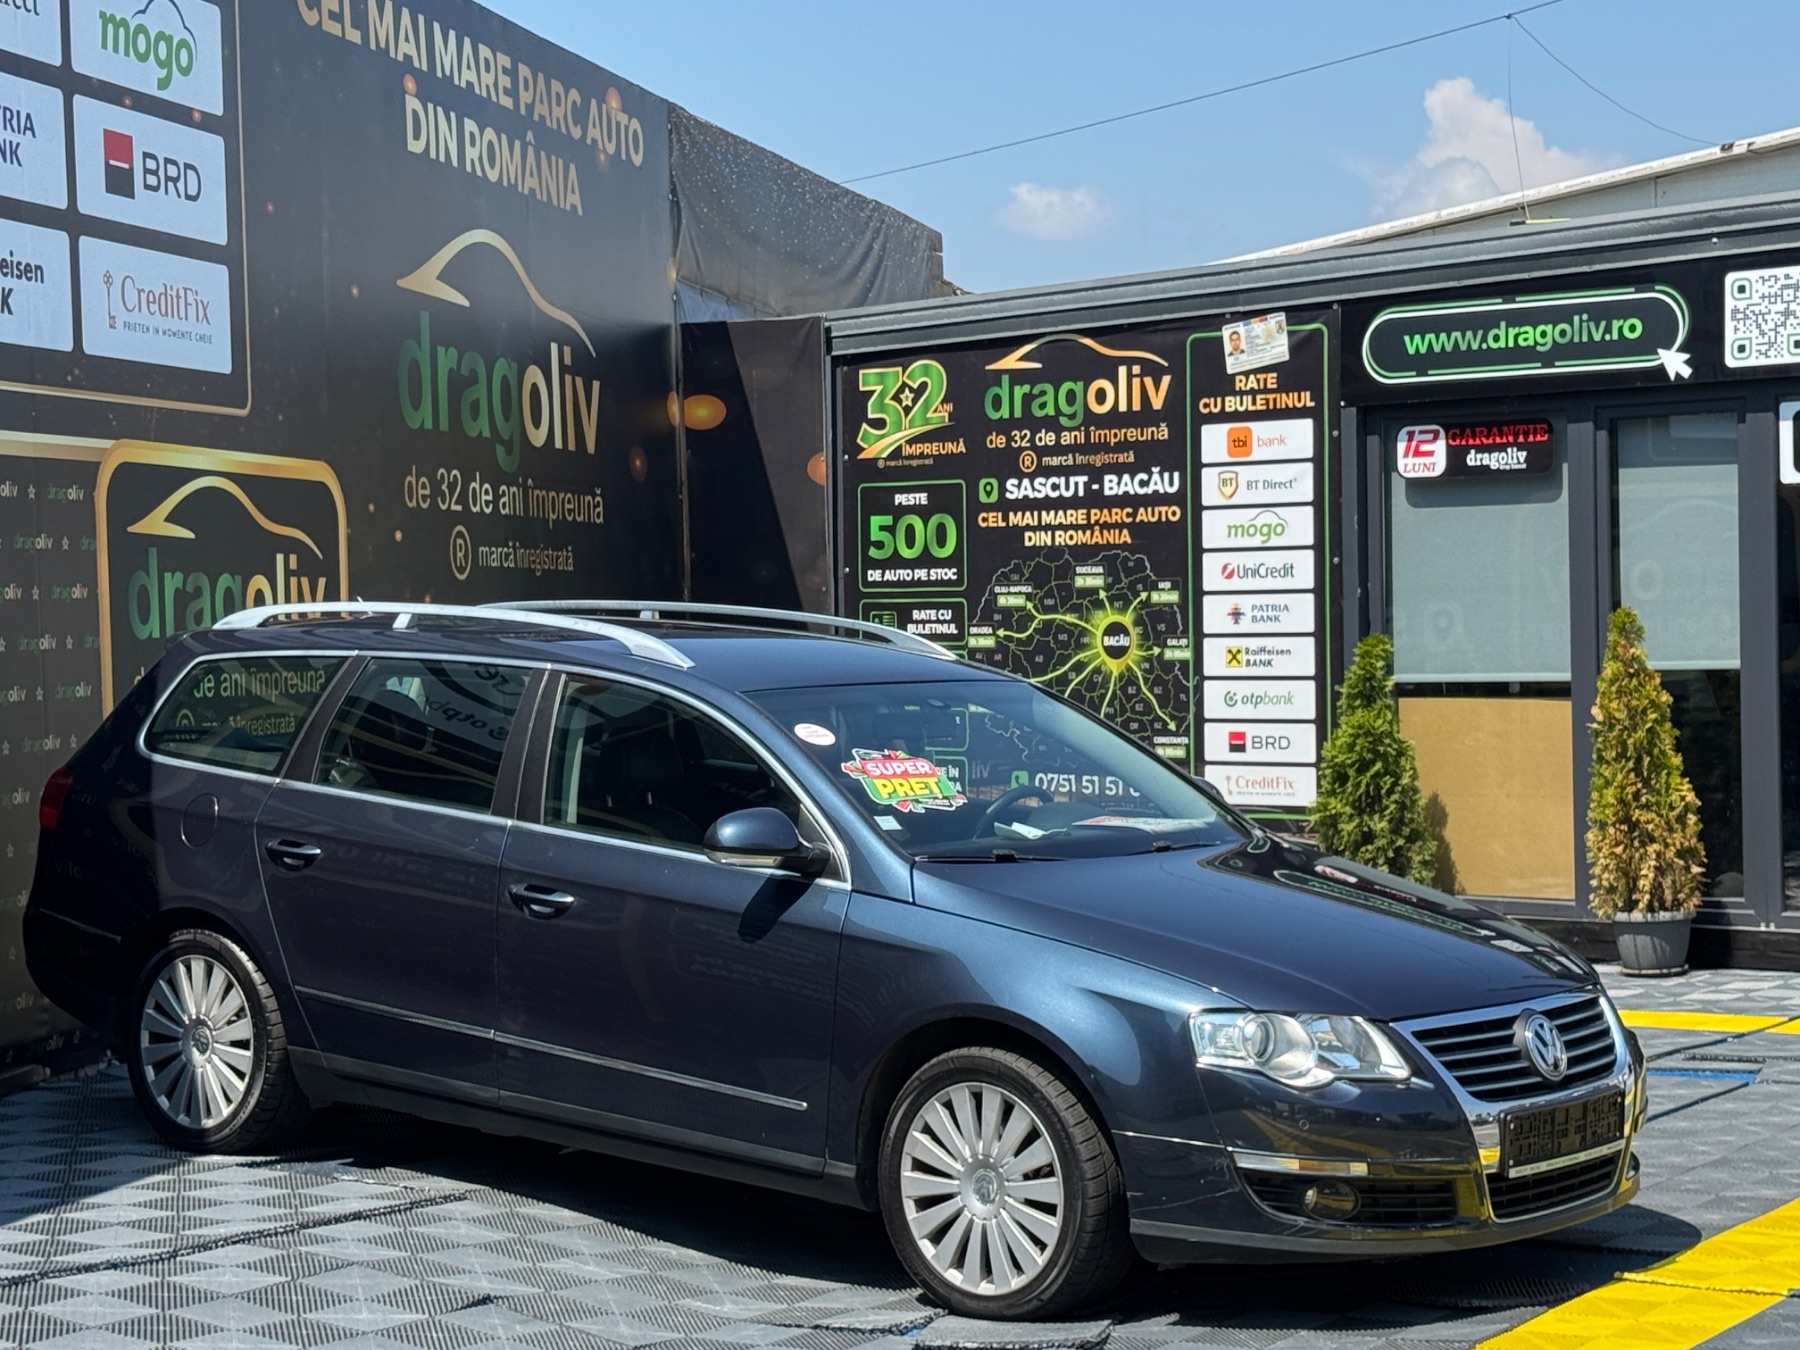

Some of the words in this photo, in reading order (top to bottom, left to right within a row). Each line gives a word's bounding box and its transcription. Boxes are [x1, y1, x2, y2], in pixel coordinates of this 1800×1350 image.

[99, 10, 195, 91] mogo
[367, 0, 428, 72] MAI
[433, 20, 514, 110] MARE
[518, 61, 582, 140] PARC
[587, 98, 644, 167] AUTO
[0, 104, 37, 139] RIA
[404, 94, 459, 168] DIN
[464, 116, 583, 216] ROMÂNIA
[142, 150, 202, 202] BRD
[120, 275, 211, 326] CreditFix
[1403, 314, 1643, 355] www.dragoliv.ro
[398, 310, 600, 473] dragoliv
[1235, 373, 1277, 391] RATE
[984, 364, 1172, 427] dragoliv
[1199, 398, 1222, 414] CU
[1224, 391, 1315, 412] BULETINUL
[986, 432, 1006, 449] de
[1011, 430, 1031, 448] 32
[1035, 428, 1056, 446] de
[1060, 427, 1085, 445] ani
[1090, 422, 1169, 447] împreună
[1232, 435, 1247, 448] tbi
[1257, 434, 1286, 448] bank
[1403, 429, 1441, 459] 12
[1448, 424, 1549, 446] GARANTIE
[902, 438, 966, 457] ÎMPREUNĂ
[1466, 446, 1528, 470] dragoliv
[1042, 452, 1074, 467] marcă
[1075, 450, 1135, 468] înregistrată
[1403, 462, 1436, 474] LUNI
[1005, 475, 1088, 500] SASCUT
[1103, 466, 1180, 497] BACĂU
[1222, 477, 1234, 487] BT
[1246, 480, 1260, 490] BT
[404, 465, 431, 509] de
[437, 467, 463, 511] 32
[468, 471, 493, 514] de
[499, 477, 524, 517] ani
[528, 478, 604, 529] împreună
[894, 493, 928, 506] PESTE
[978, 511, 1006, 527] CEL
[1008, 510, 1038, 526] MAI
[1041, 508, 1088, 525] MARE
[1090, 507, 1133, 524] PARC
[1135, 505, 1181, 523] AUTO
[868, 513, 957, 560] 500
[1024, 531, 1052, 547] DIN
[1055, 526, 1131, 546] ROMÂNIA
[1227, 521, 1286, 544] mogo
[479, 541, 515, 568] marcă
[867, 569, 882, 581] DE
[884, 569, 912, 581] AUTO
[914, 569, 928, 580] PE
[929, 568, 958, 580] STOC
[1237, 562, 1294, 579] UniCredit
[912, 610, 937, 620] RATE
[938, 609, 952, 620] CU
[1251, 603, 1290, 613] PATRIA
[907, 623, 958, 634] BULETINUL
[1251, 614, 1281, 624] BANK
[1103, 634, 1130, 646] BACĂU
[1244, 645, 1291, 656] Raiffeisen
[1245, 658, 1274, 668] BANK
[1241, 691, 1294, 709] otpbank
[1252, 735, 1291, 751] BRD
[865, 761, 934, 776] SUPER
[872, 777, 943, 799] PREȚ
[1034, 772, 1076, 793] 0751
[1081, 775, 1100, 795] 51
[1105, 776, 1124, 796] 51
[1236, 774, 1295, 790] CreditFix
